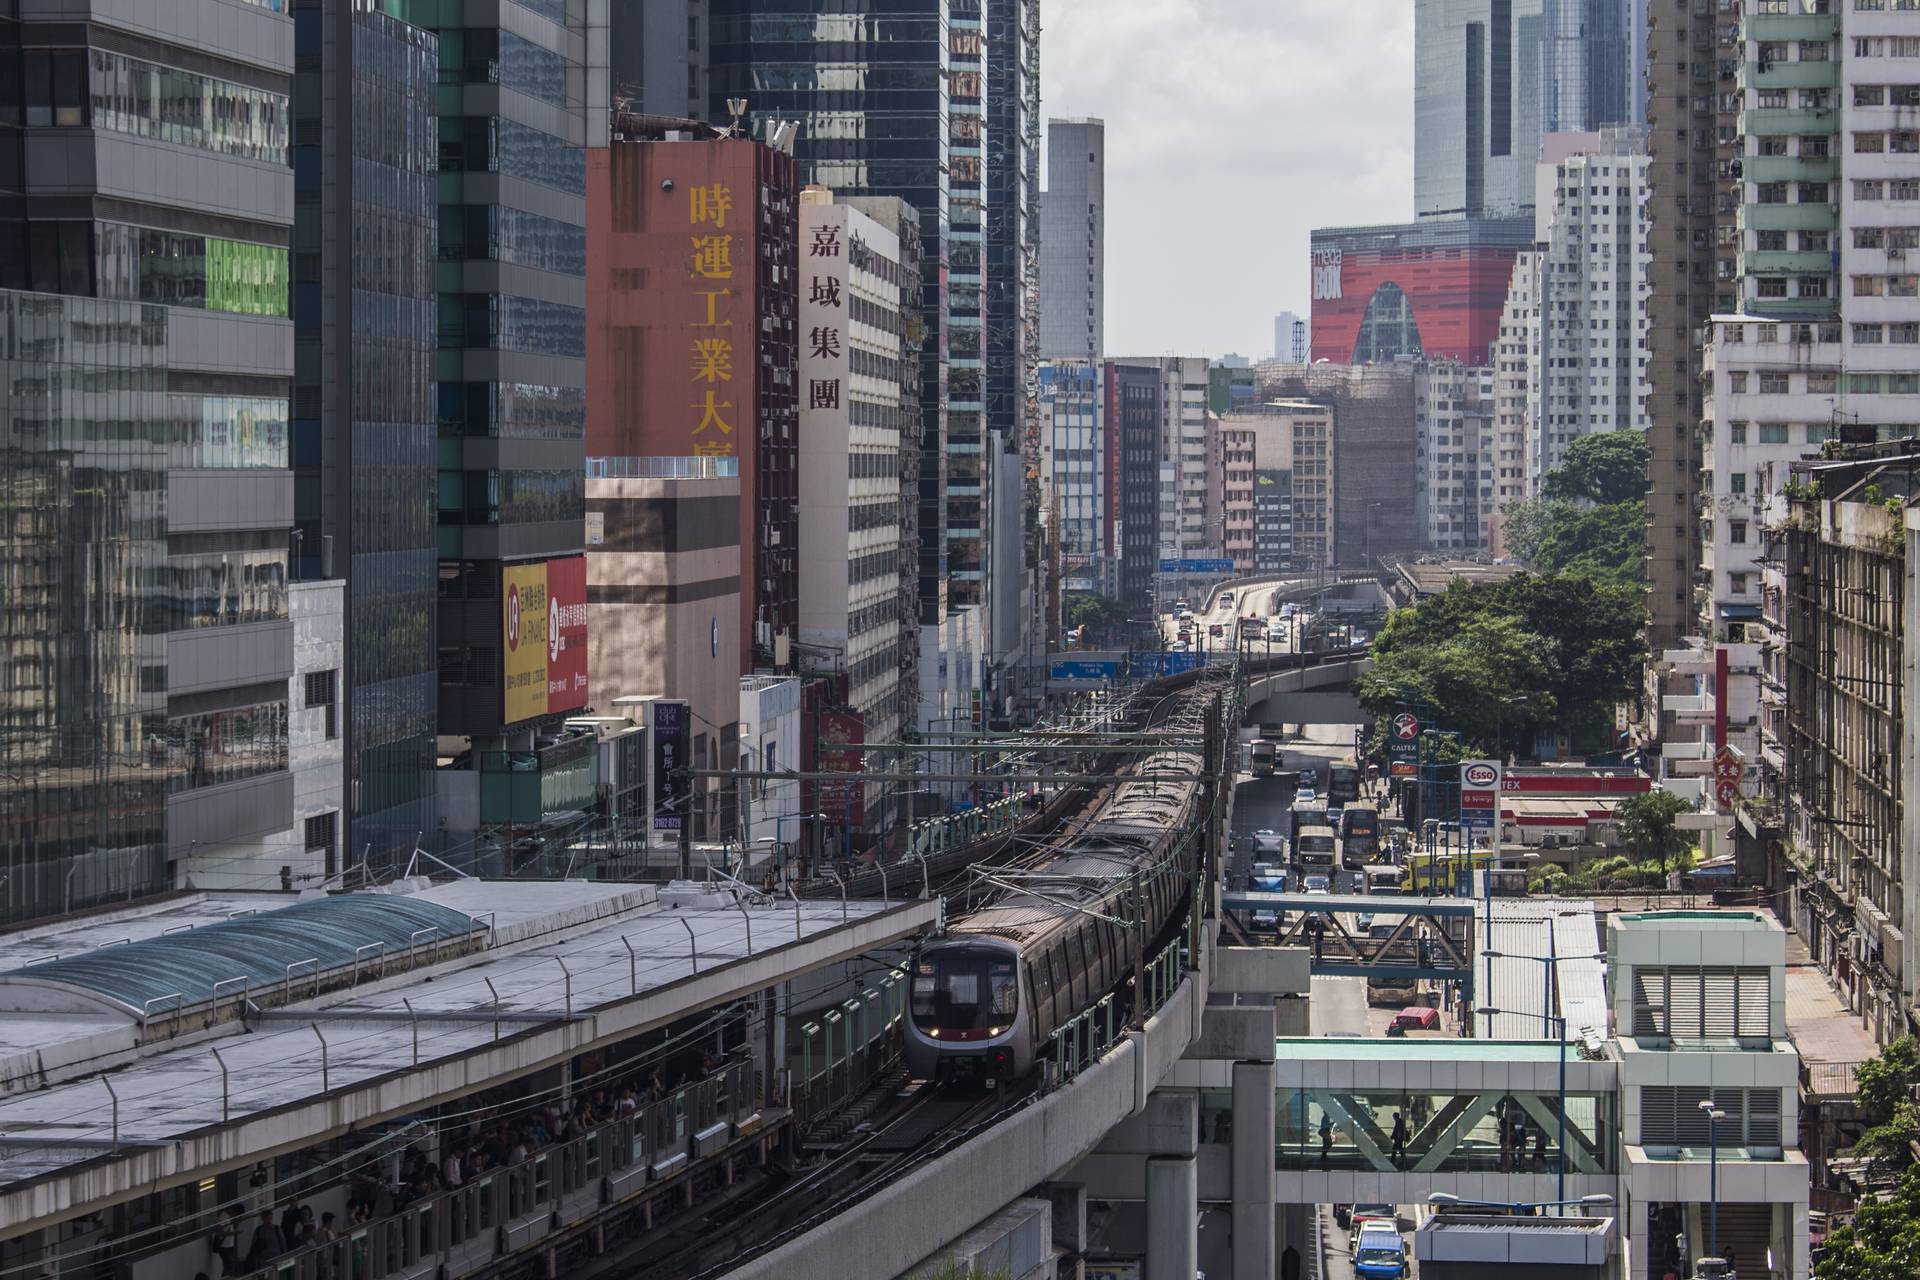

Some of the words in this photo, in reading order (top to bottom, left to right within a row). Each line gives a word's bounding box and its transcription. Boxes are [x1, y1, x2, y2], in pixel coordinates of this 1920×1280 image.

[1313, 249, 1342, 265] mega
[1313, 265, 1342, 300] BOX
[808, 224, 841, 411] 嘉域集團
[1470, 770, 1493, 779] Esso
